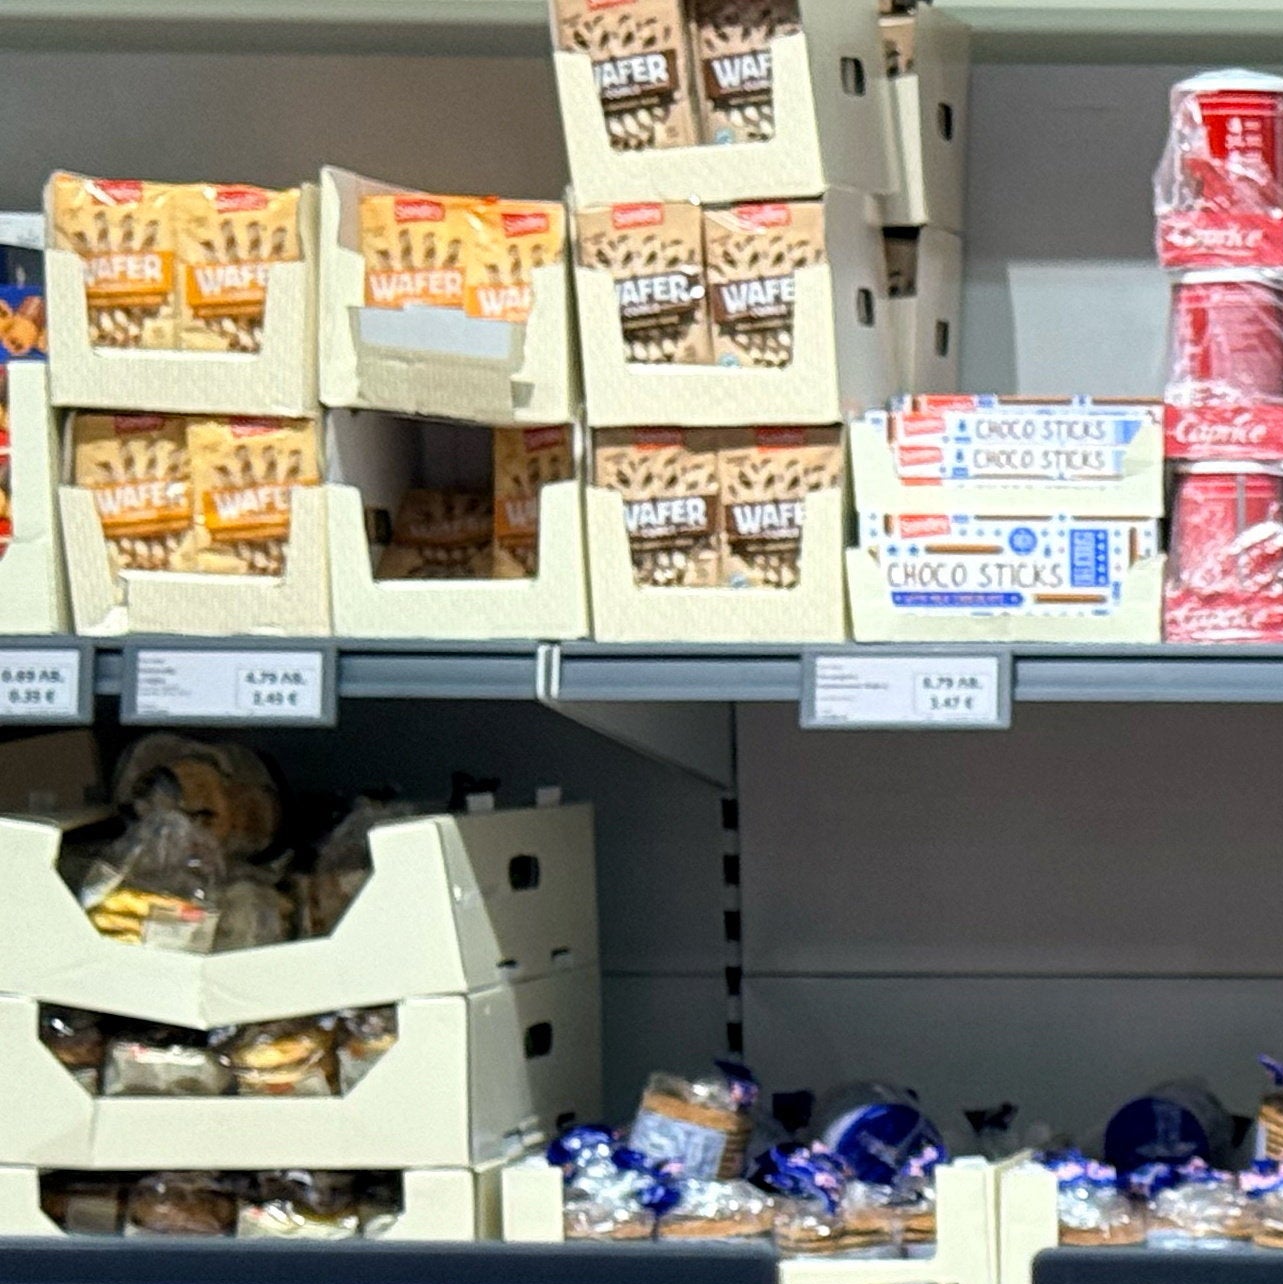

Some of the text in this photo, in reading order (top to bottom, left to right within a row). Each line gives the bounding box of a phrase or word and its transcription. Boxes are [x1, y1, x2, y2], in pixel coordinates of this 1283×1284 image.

[369, 270, 463, 301] WAFER
[976, 420, 1106, 440] CHOCO STICKS
[973, 449, 1105, 470] CHOCO STICKS
[887, 562, 1063, 589] CHOCO STICKS
